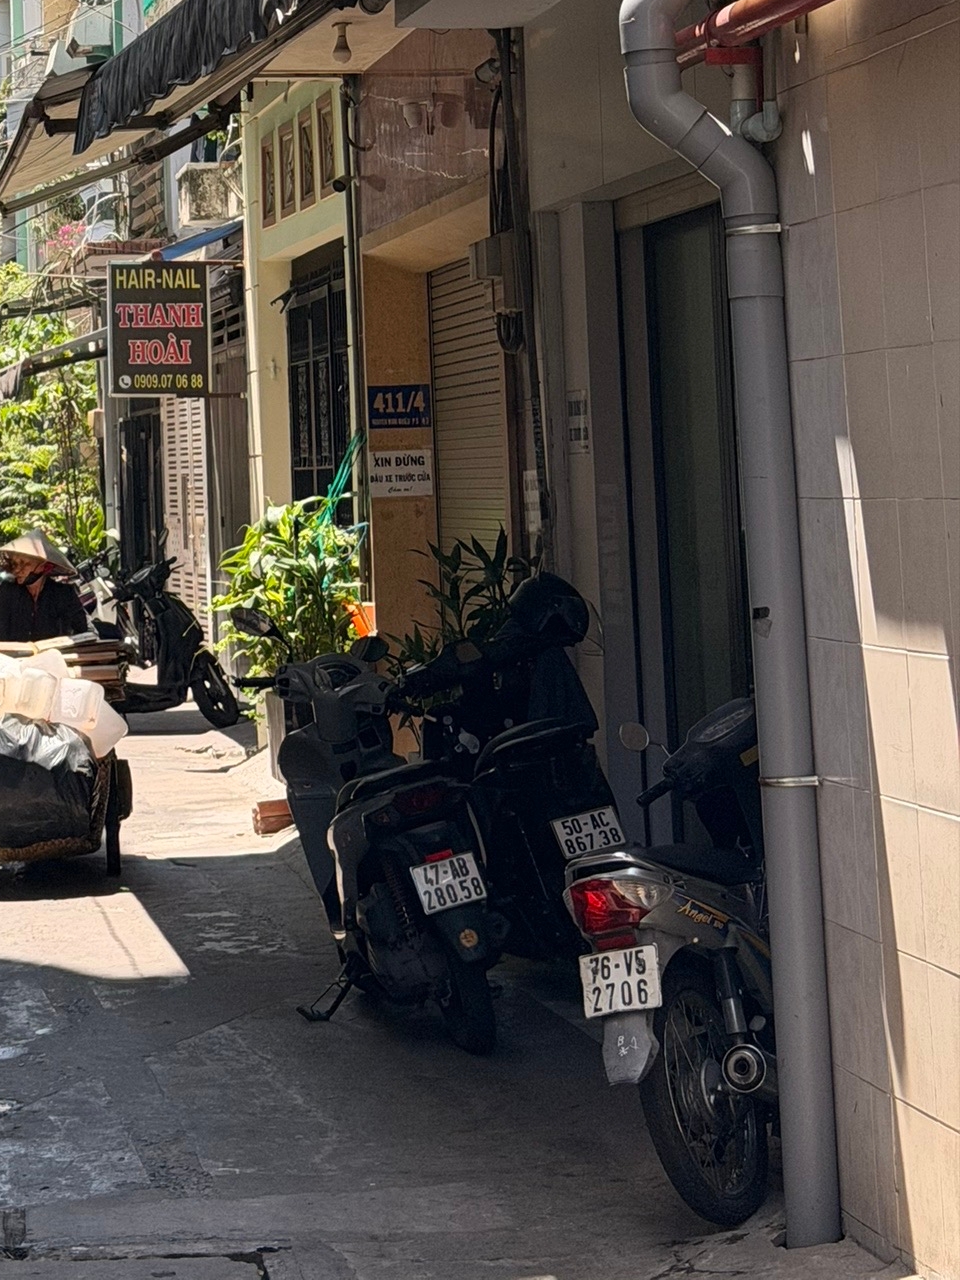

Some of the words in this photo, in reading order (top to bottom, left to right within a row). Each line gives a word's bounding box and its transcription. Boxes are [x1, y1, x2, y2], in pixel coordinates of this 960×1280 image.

[115, 268, 201, 289] HAIR-NAIL
[115, 302, 204, 328] THANH
[128, 332, 192, 365] HOÀI
[134, 373, 172, 388] 0909.07
[175, 373, 188, 388] 06
[190, 373, 203, 388] 88
[373, 391, 425, 413] 411/4
[373, 456, 391, 467] XIN
[395, 453, 425, 467] ĐỪNG
[385, 474, 393, 483] XE
[561, 811, 610, 836] 50-AC
[564, 827, 621, 855] 867.38
[423, 857, 470, 886] 47-AB
[423, 877, 483, 911] 280.58
[676, 900, 714, 924] Angel
[592, 978, 648, 1013] 2706
